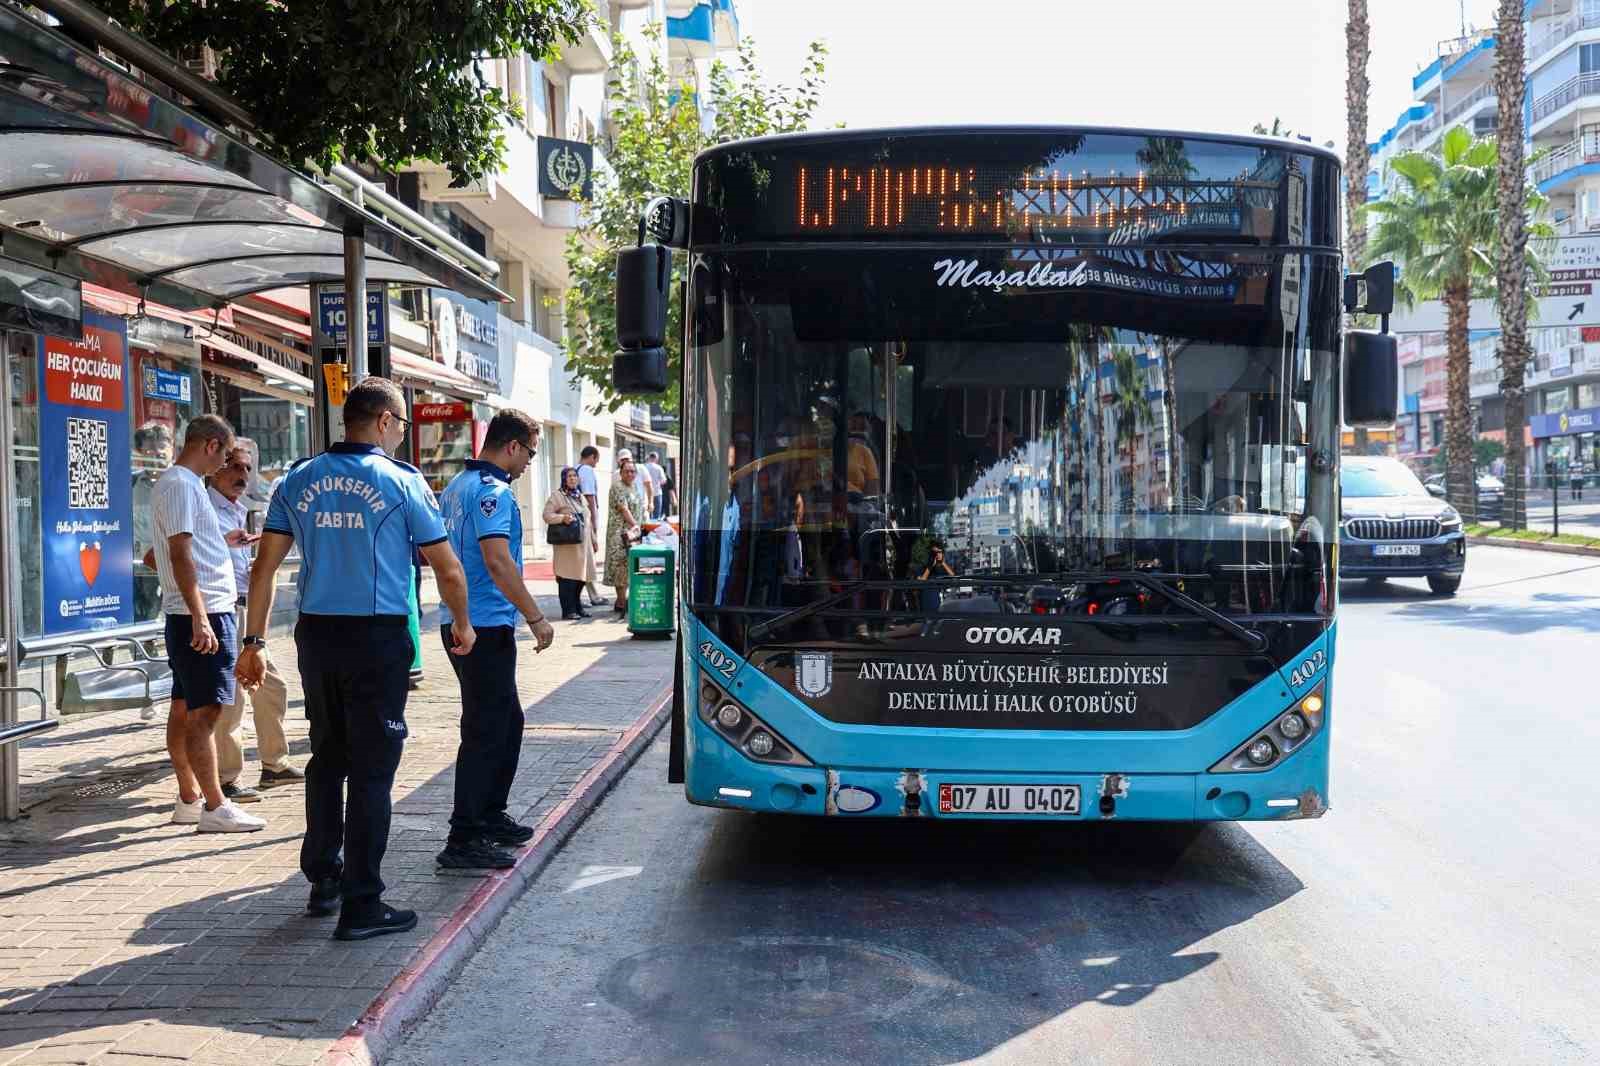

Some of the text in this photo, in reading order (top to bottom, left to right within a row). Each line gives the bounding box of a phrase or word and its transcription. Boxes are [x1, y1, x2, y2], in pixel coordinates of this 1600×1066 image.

[933, 258, 1088, 293] Maşallah
[47, 352, 121, 380] HER ÇOCUĞUN
[70, 382, 103, 402] HAKKI
[314, 511, 364, 529] ZABTA
[965, 627, 1063, 646] OTOKAR
[700, 640, 738, 681] 402
[1289, 650, 1327, 688] 402
[857, 662, 937, 681] ANTALYA
[942, 660, 1061, 688] BÜYÜKŞEHİR
[1066, 661, 1169, 685] BELEDİYESİ
[888, 690, 1138, 713] DENETİMLİ HALK OTOBÜSÜ
[952, 787, 1076, 811] 07 AU 0402
